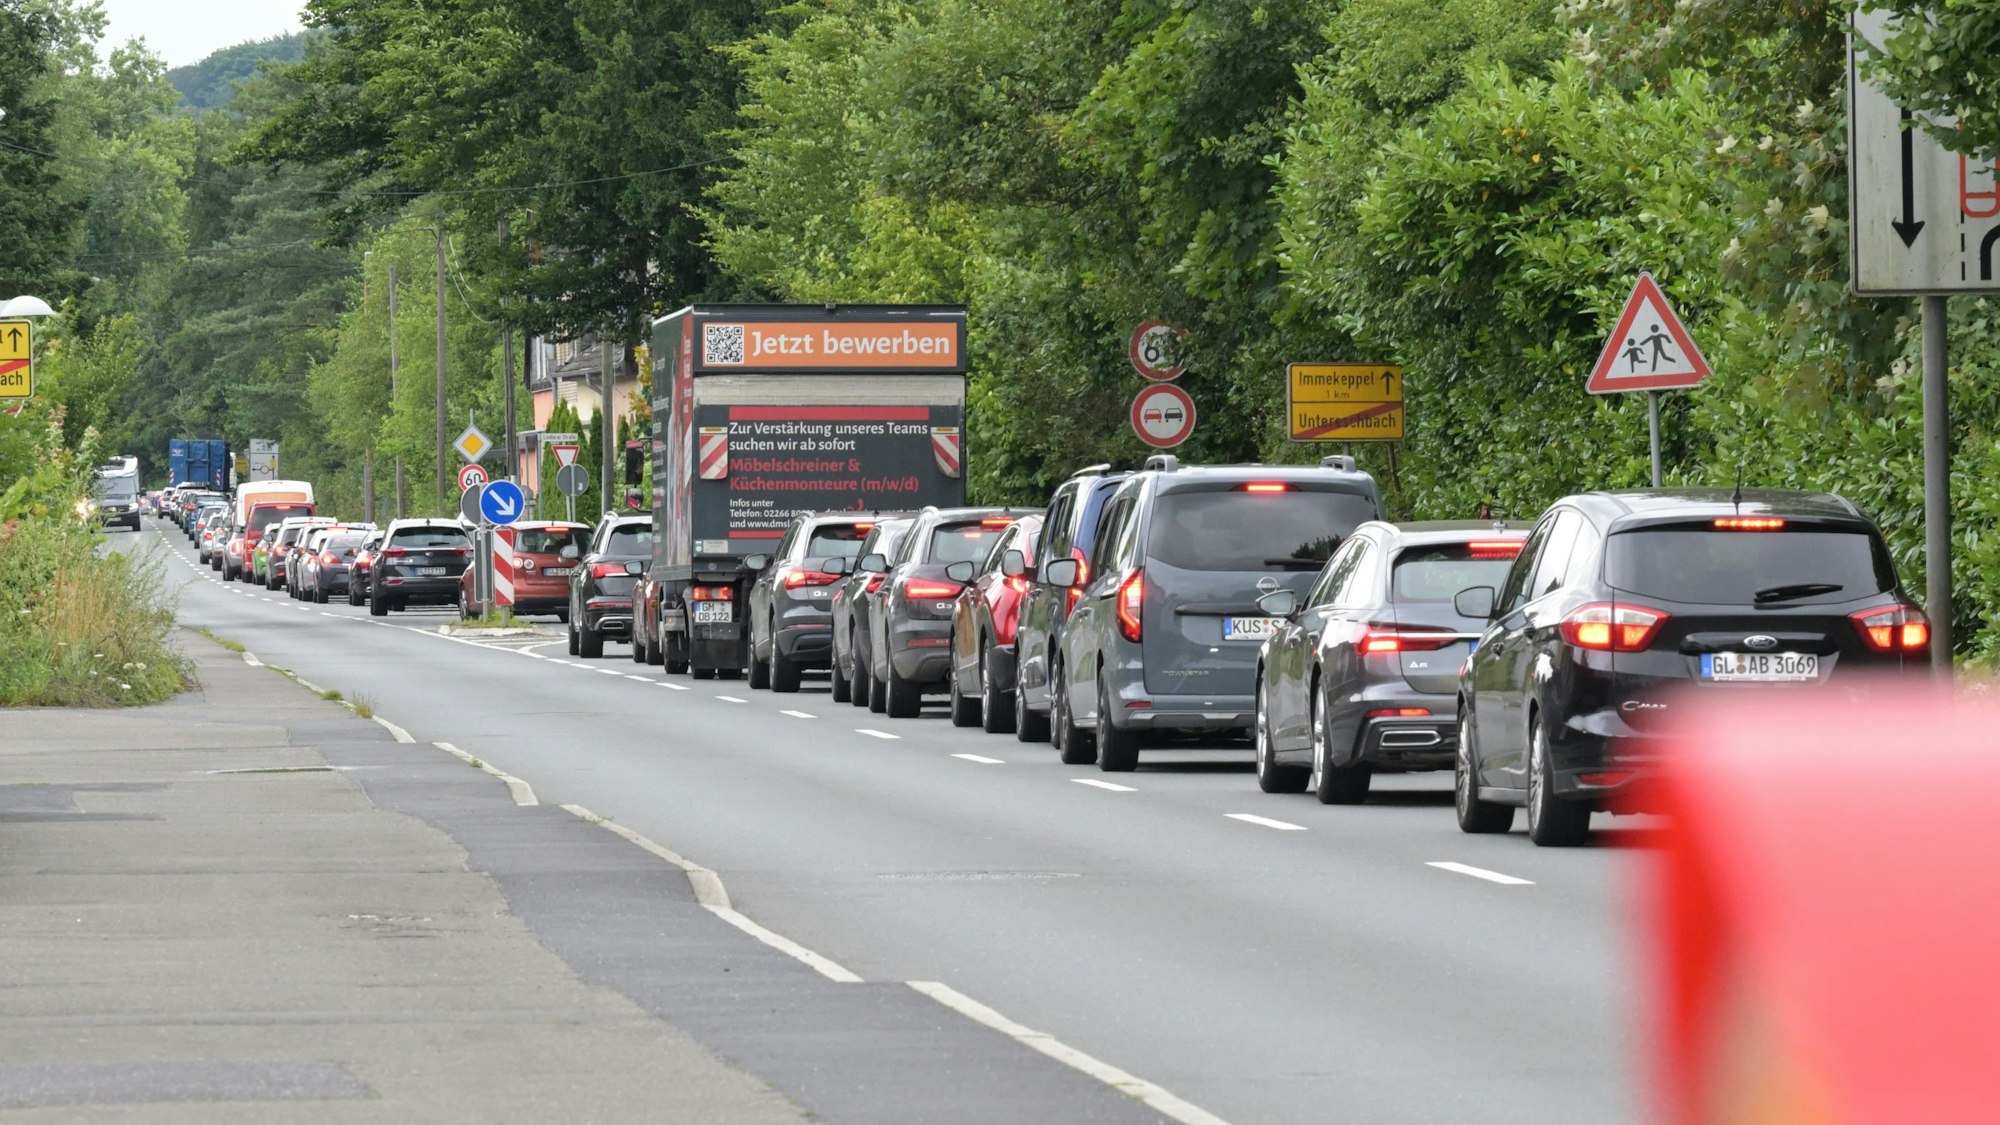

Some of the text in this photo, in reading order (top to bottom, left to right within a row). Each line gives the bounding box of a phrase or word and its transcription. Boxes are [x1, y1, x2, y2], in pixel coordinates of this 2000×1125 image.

[752, 330, 950, 356] Jetzt bewerben
[0, 371, 23, 386] ach
[1299, 371, 1375, 389] Immekeppel
[1334, 390, 1350, 399] km
[1299, 414, 1396, 429] Untereschbach
[729, 422, 928, 437] Zur Verstärkung unseres Teams
[729, 438, 856, 451] suchen wir ab sofort
[729, 458, 861, 473] Möbelschreiner &
[465, 473, 482, 486] 60
[729, 477, 919, 492] Küchenmonteure (m/w/d)
[730, 499, 774, 508] Infos unter
[730, 509, 762, 518] Telefon:
[764, 510, 789, 518] 02266
[730, 519, 791, 529] und www.dmsl
[702, 603, 715, 611] GM
[699, 613, 730, 621] DB 122
[1232, 620, 1261, 633] KUS
[1713, 656, 1735, 674] GL
[1748, 656, 1770, 674] AB
[1775, 656, 1816, 674] 3069
